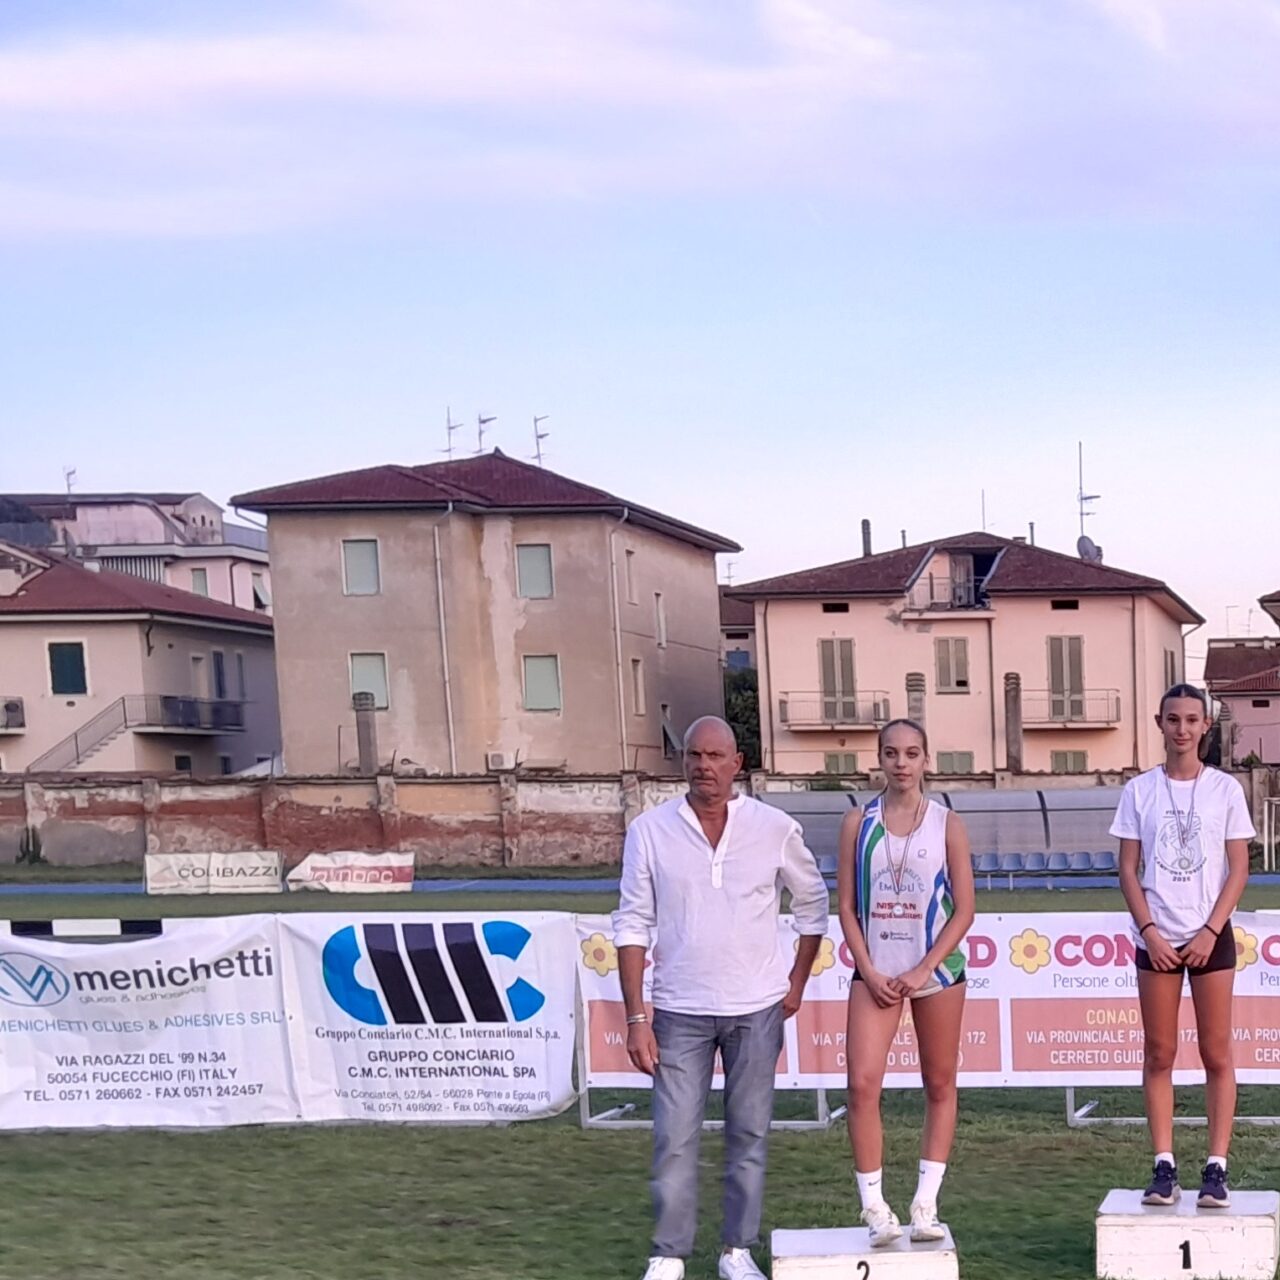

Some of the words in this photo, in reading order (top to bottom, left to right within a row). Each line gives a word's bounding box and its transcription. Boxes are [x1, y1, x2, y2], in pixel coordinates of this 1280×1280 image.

[878, 881, 916, 893] EMOLI
[876, 902, 917, 911] NISAN
[1054, 934, 1137, 967] CON
[73, 947, 275, 992] menichetti
[966, 976, 990, 990] ose
[1052, 973, 1110, 988] Persone
[1114, 973, 1138, 988] olt
[91, 1020, 145, 1033] GLUES
[149, 1019, 159, 1031] &
[163, 1011, 247, 1029] ADHESIVES
[1086, 1009, 1139, 1025] CONAD
[315, 1026, 356, 1042] Gruppo
[358, 1027, 412, 1041] Conciario
[414, 1027, 457, 1040] C.M.C.
[460, 1026, 533, 1040] International
[535, 1027, 562, 1042] S.p.a.
[604, 1032, 624, 1046] VIA
[812, 1033, 832, 1046] VIA
[966, 1031, 988, 1045] 172
[1026, 1031, 1046, 1044] VIA
[1051, 1029, 1125, 1044] PROVINCIALE
[1232, 1028, 1251, 1042] VIA
[55, 1055, 79, 1067] VIA
[83, 1053, 145, 1066] RAGAZZI
[149, 1053, 175, 1065] DEL
[367, 1049, 429, 1062] GRUPPO
[432, 1049, 516, 1062] CONCIARIO
[1050, 1050, 1110, 1065] CERRETO
[1113, 1050, 1146, 1065] GUID
[47, 1072, 88, 1085] 50054
[92, 1070, 174, 1084] FUCECCHIO
[176, 1068, 196, 1083] (FI)
[199, 1067, 238, 1080] ITALY
[347, 1066, 392, 1079] C.M.C.
[395, 1066, 509, 1079] INTERNATIONAL
[513, 1066, 537, 1079] SPA
[24, 1089, 55, 1102] TEL.
[58, 1088, 91, 1101] 0571
[96, 1087, 143, 1100] 260662
[155, 1085, 181, 1099] FAX
[183, 1085, 213, 1098] 0571
[216, 1083, 264, 1098] 242457
[334, 1089, 349, 1099] Via
[477, 1089, 503, 1100] Ponte
[453, 1102, 471, 1112] Fax
[1179, 1240, 1192, 1270] 1
